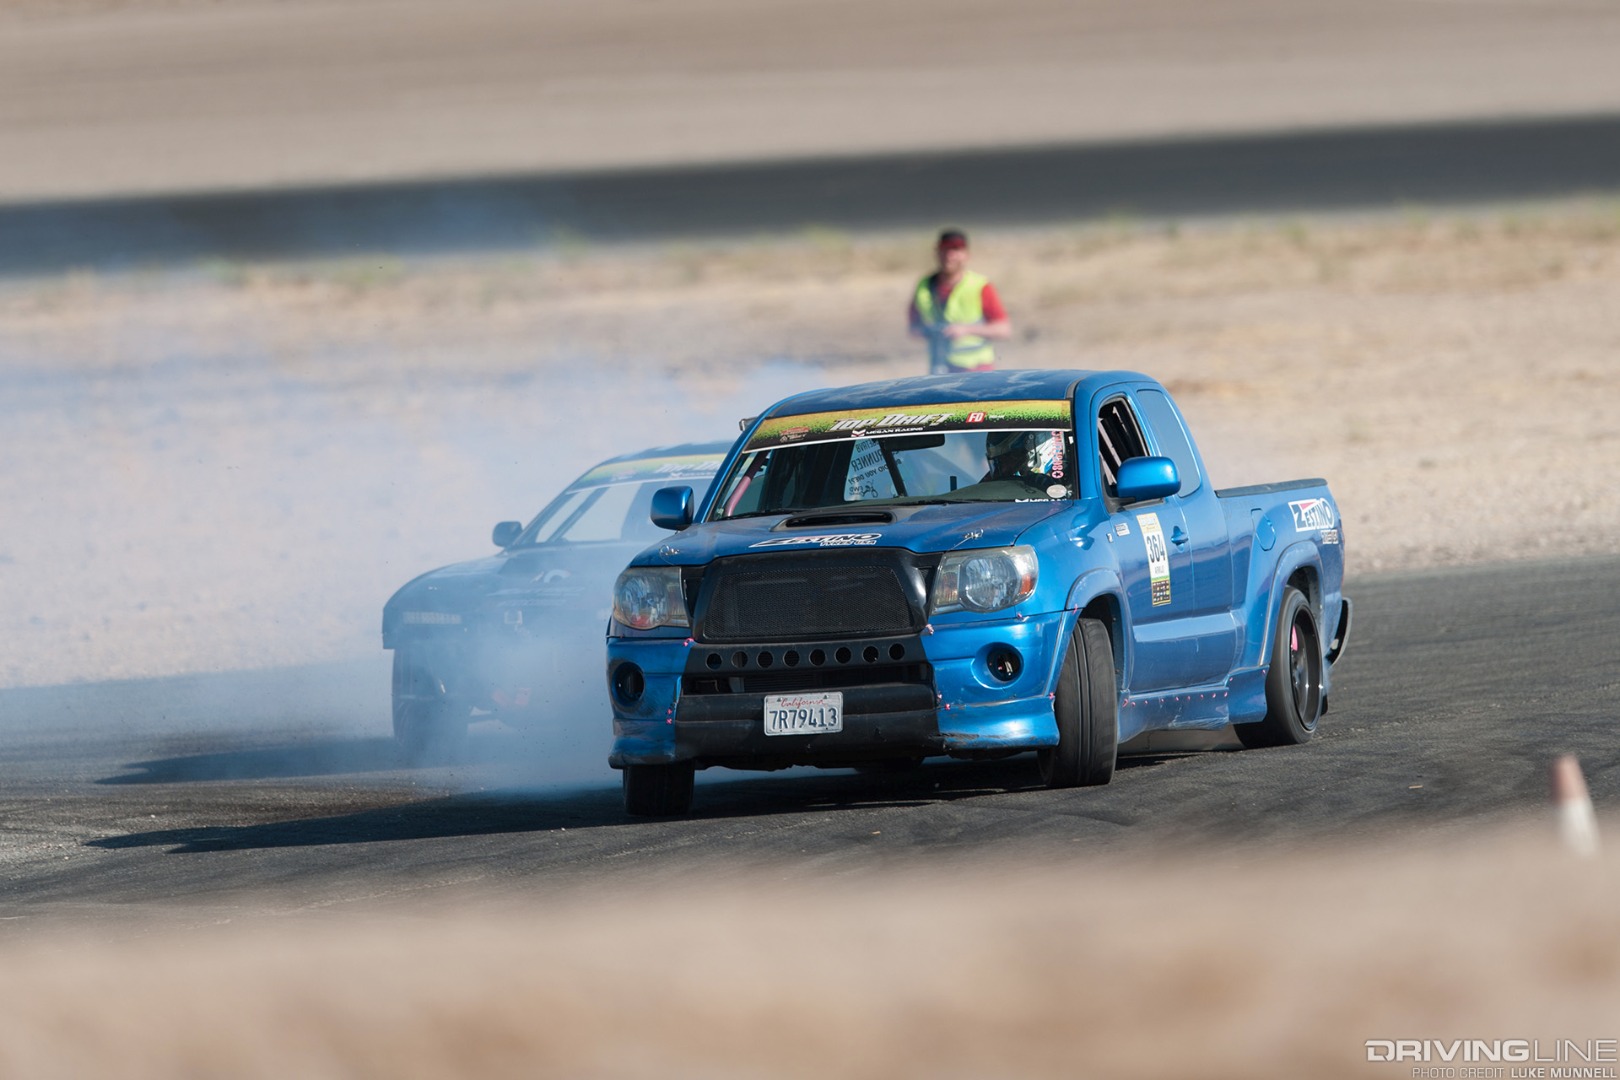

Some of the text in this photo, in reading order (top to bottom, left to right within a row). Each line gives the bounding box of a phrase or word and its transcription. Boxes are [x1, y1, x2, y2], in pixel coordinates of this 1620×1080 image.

[827, 418, 878, 431] TOP
[968, 412, 983, 422] FD
[1288, 497, 1334, 532] ZESTINO
[1146, 534, 1166, 563] 364
[781, 697, 825, 708] California
[769, 707, 837, 730] 7R79413
